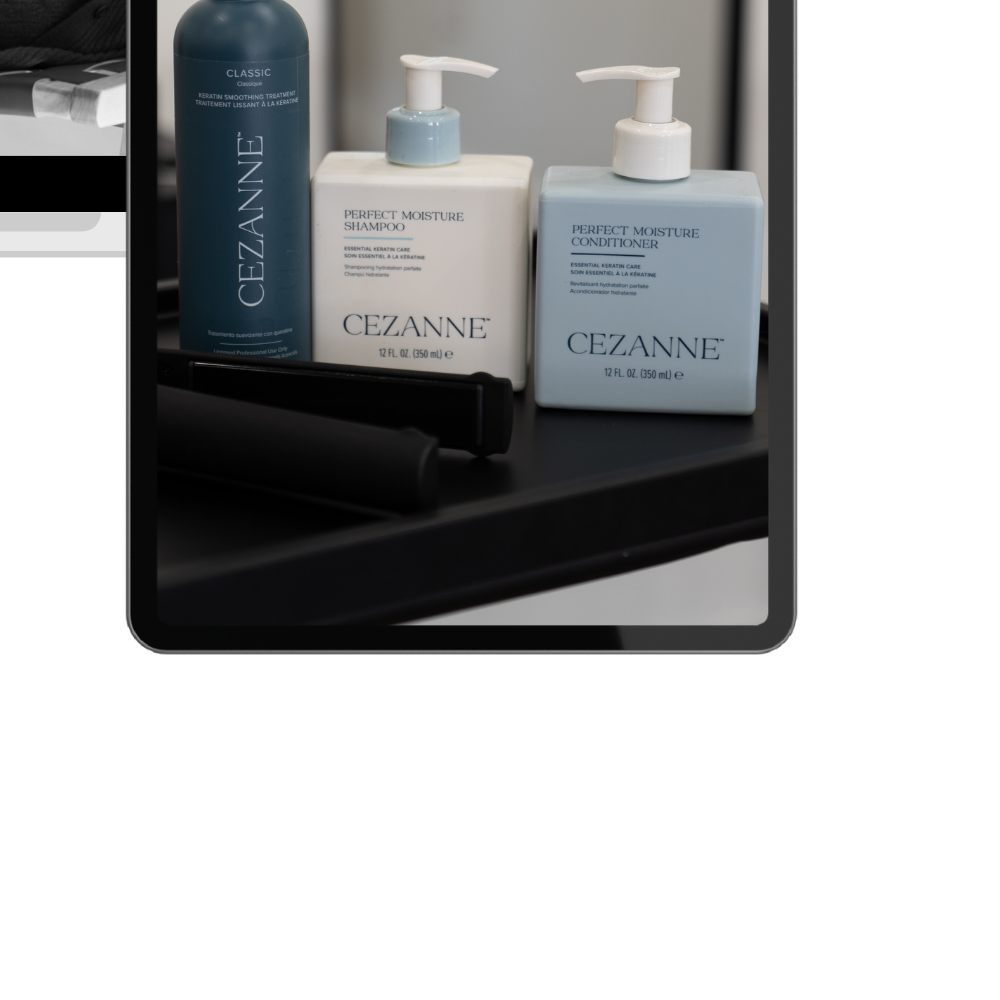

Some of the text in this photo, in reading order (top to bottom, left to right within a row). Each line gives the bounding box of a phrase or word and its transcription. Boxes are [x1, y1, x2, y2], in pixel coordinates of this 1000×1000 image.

[226, 69, 271, 77] CLASSIC
[266, 91, 296, 99] TREATMENT
[276, 97, 298, 106] KÉRATINE
[344, 210, 464, 222] PERFECT MOISTURE
[344, 222, 405, 231] SHAMPOO
[572, 225, 700, 238] PERFECT MOISTURE
[572, 237, 658, 249] CONDITIONER
[379, 348, 386, 357] 12
[388, 348, 398, 357] FL.
[413, 349, 428, 359] (350
[604, 368, 612, 377] 12
[615, 368, 624, 378] FL.
[640, 369, 656, 379] (350
